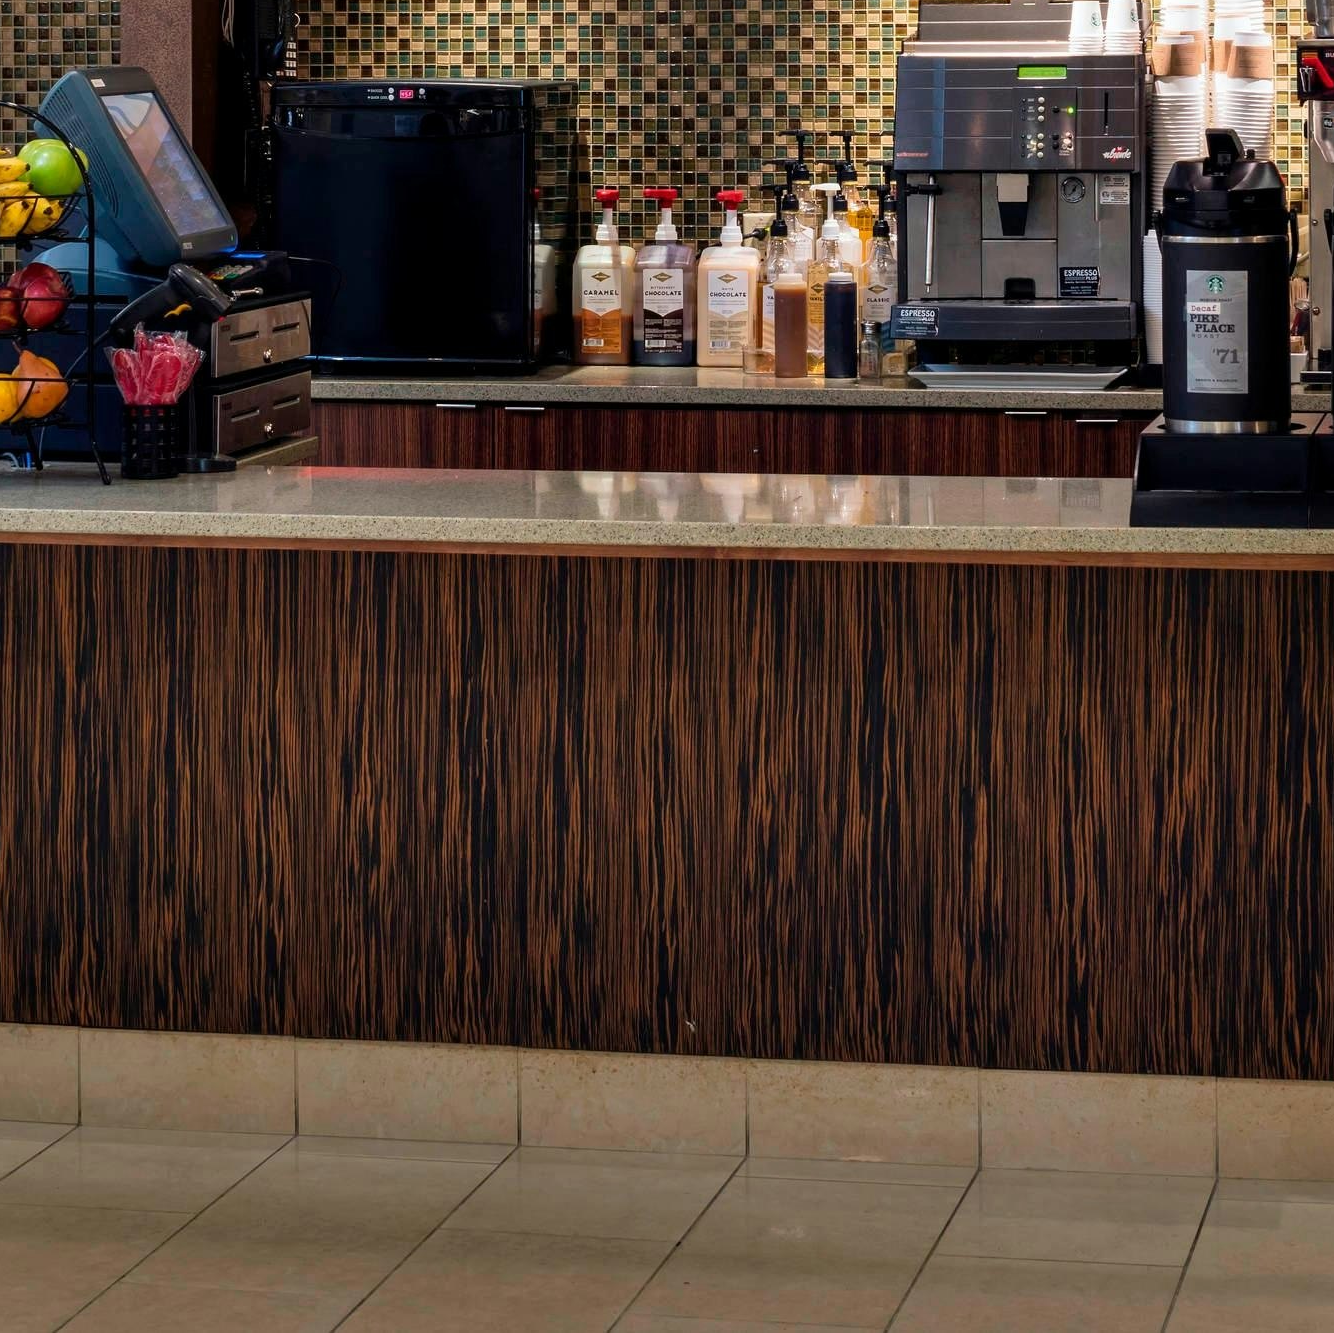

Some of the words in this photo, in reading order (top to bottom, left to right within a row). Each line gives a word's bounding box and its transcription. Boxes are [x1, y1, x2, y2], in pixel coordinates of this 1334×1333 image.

[1191, 304, 1217, 312] Decaf
[900, 309, 935, 317] ESPRESSO
[1190, 314, 1219, 323] PIKE
[1195, 324, 1235, 333] PLACE
